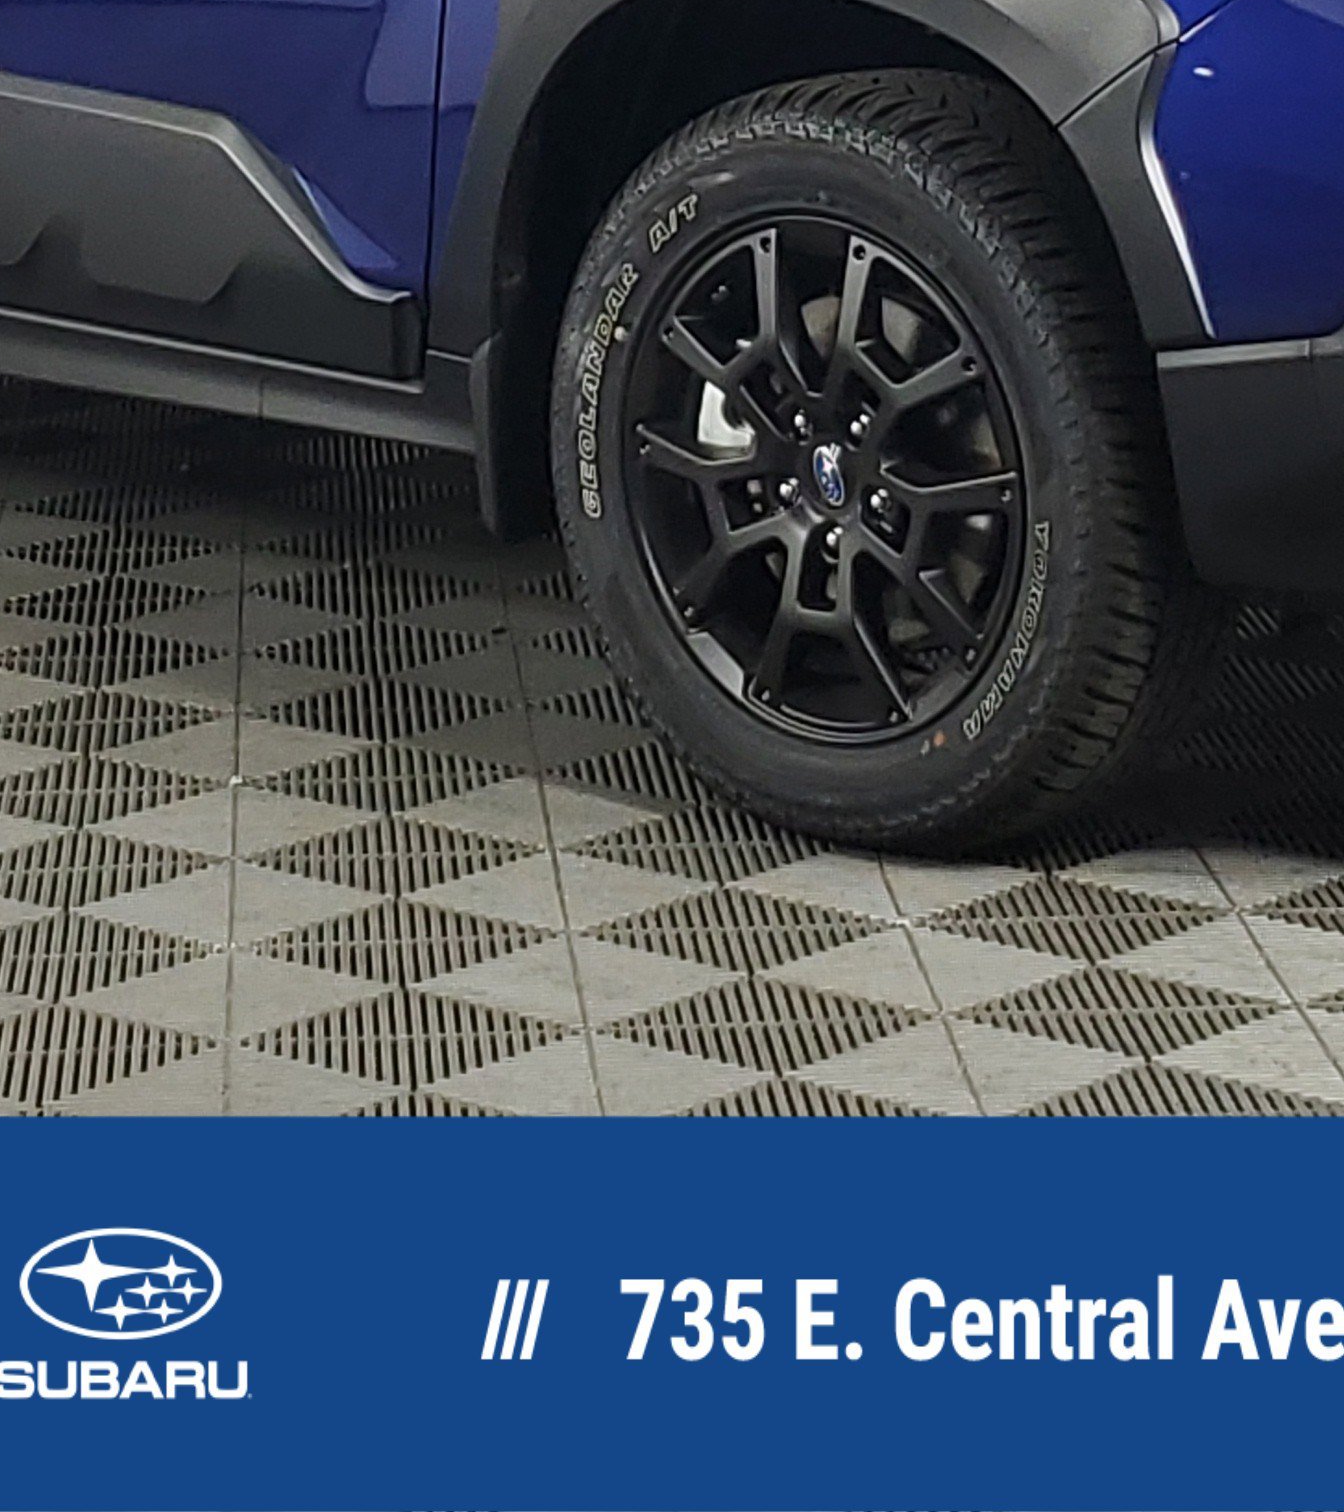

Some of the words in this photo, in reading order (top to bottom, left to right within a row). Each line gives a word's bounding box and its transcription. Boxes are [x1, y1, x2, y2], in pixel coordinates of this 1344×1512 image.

[648, 193, 698, 253] A/T
[578, 262, 639, 519] GEOLANDAR
[963, 520, 1050, 740] YOKOHAMA
